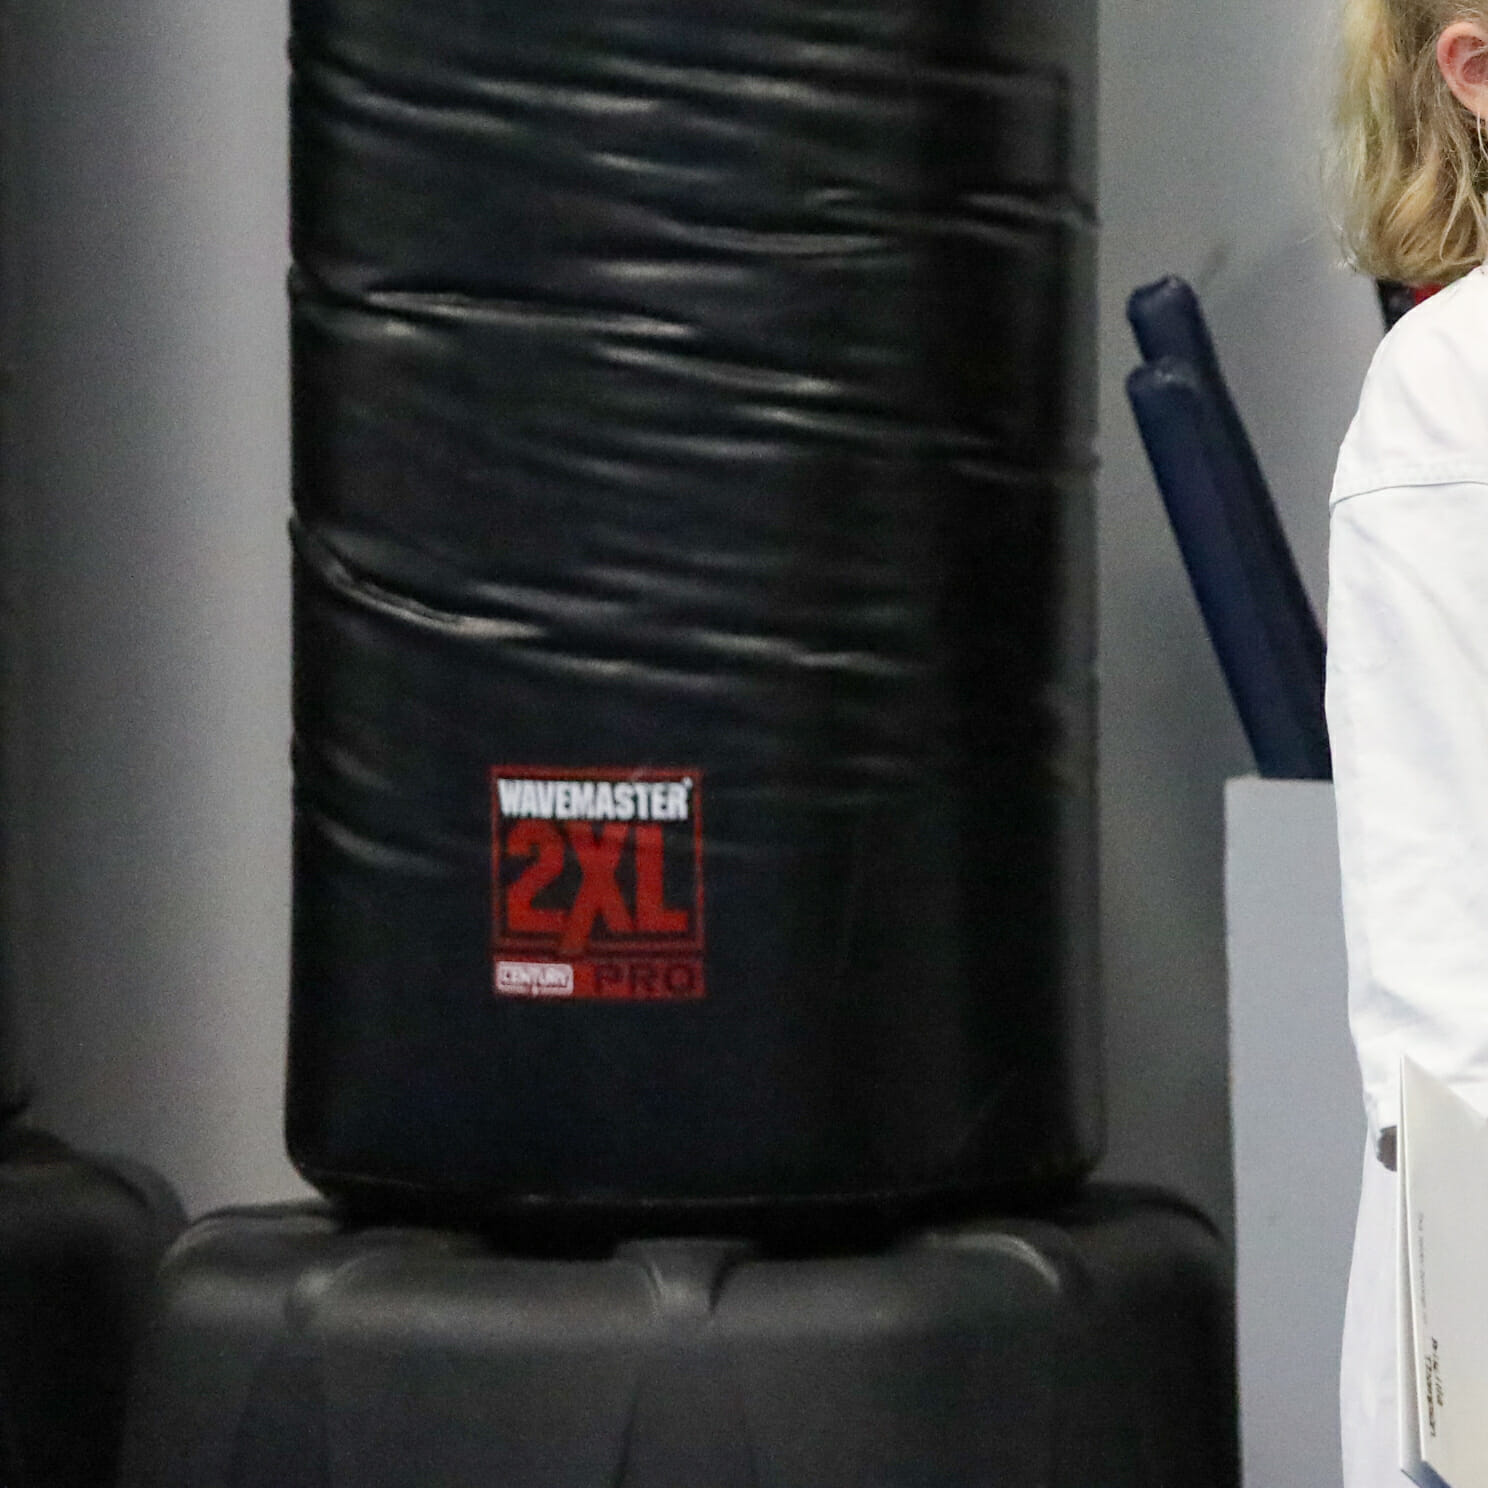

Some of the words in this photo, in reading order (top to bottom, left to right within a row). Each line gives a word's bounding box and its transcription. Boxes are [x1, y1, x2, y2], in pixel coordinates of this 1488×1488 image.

[497, 777, 692, 821] WAVEMASTER
[506, 819, 689, 950] 2XL
[594, 964, 698, 994] PRO
